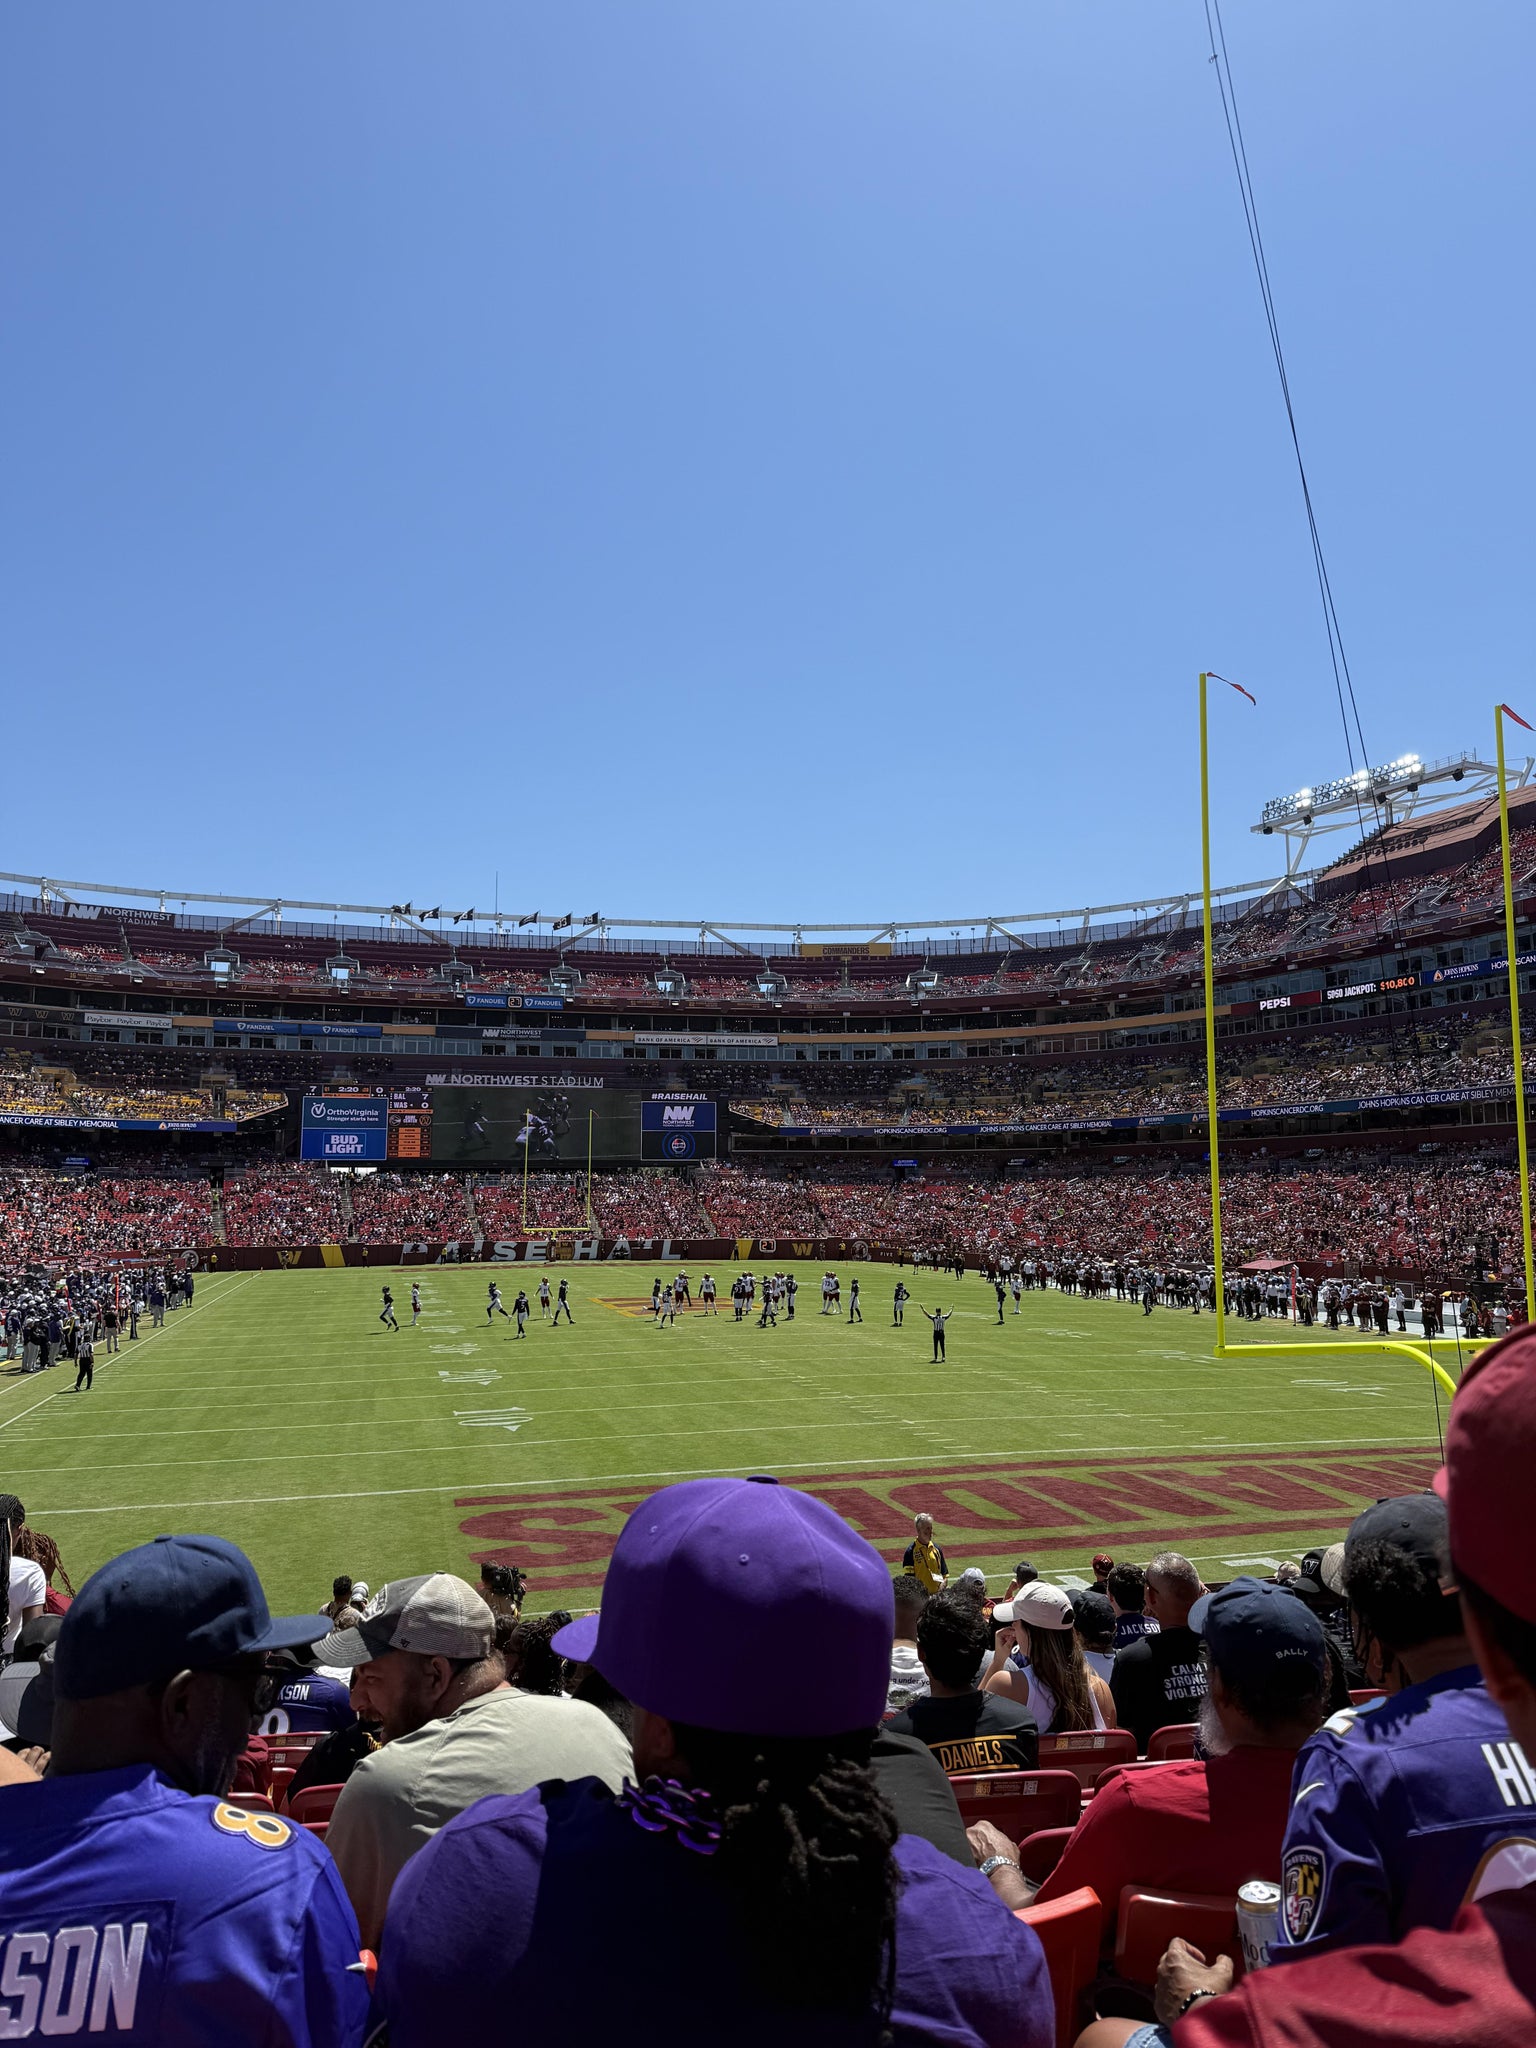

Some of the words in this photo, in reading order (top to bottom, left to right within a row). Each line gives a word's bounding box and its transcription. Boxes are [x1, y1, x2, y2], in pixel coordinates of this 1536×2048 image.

[103, 907, 172, 921] NORTHWEST
[117, 917, 158, 926] STADIUM
[822, 946, 870, 955] COMMANDERS
[1491, 955, 1536, 970] HOPKSCAN
[1443, 966, 1459, 977] JOHNS
[1458, 963, 1479, 974] HOPKINS
[1344, 983, 1377, 998] JACKPOT:
[1260, 996, 1291, 1011] PEPSI
[86, 1014, 113, 1024] Paycor
[117, 1017, 143, 1026] Paycor
[146, 1019, 171, 1028] Paycor
[246, 1023, 275, 1031] FANDUEL
[450, 1074, 538, 1085] NORTHWEST
[541, 1076, 604, 1087] STADIUM
[1357, 1099, 1380, 1110] JOHNS
[1380, 1096, 1411, 1107] HOPKINS
[1411, 1093, 1440, 1105] CANCER
[1440, 1092, 1460, 1102] CARE
[1460, 1091, 1470, 1100] AT
[1470, 1089, 1495, 1100] SIBLEY
[1495, 1084, 1536, 1098] MEMIAL
[393, 1101, 408, 1109] WAS
[1250, 1104, 1324, 1118] HOPKINSCANCERDC.ORG
[327, 1108, 379, 1117] OrthoVirginia
[24, 1117, 43, 1125] CARE
[43, 1118, 53, 1126] AT
[54, 1119, 78, 1127] SIBLEY
[79, 1120, 119, 1128] MEMORIAL
[979, 1125, 999, 1133] JOHNS
[1086, 1120, 1113, 1128] MEMORIAL
[330, 1135, 359, 1144] BUD
[325, 1144, 364, 1154] LIGHT
[1275, 1648, 1309, 1660] BALLY
[1171, 1663, 1202, 1676] CALM
[1163, 1674, 1207, 1689] STRONG
[939, 1740, 1004, 1772] DANIELS
[212, 1801, 298, 1851] 8
[1285, 1854, 1319, 1867] RAVENS
[0, 1922, 148, 2039] SON
